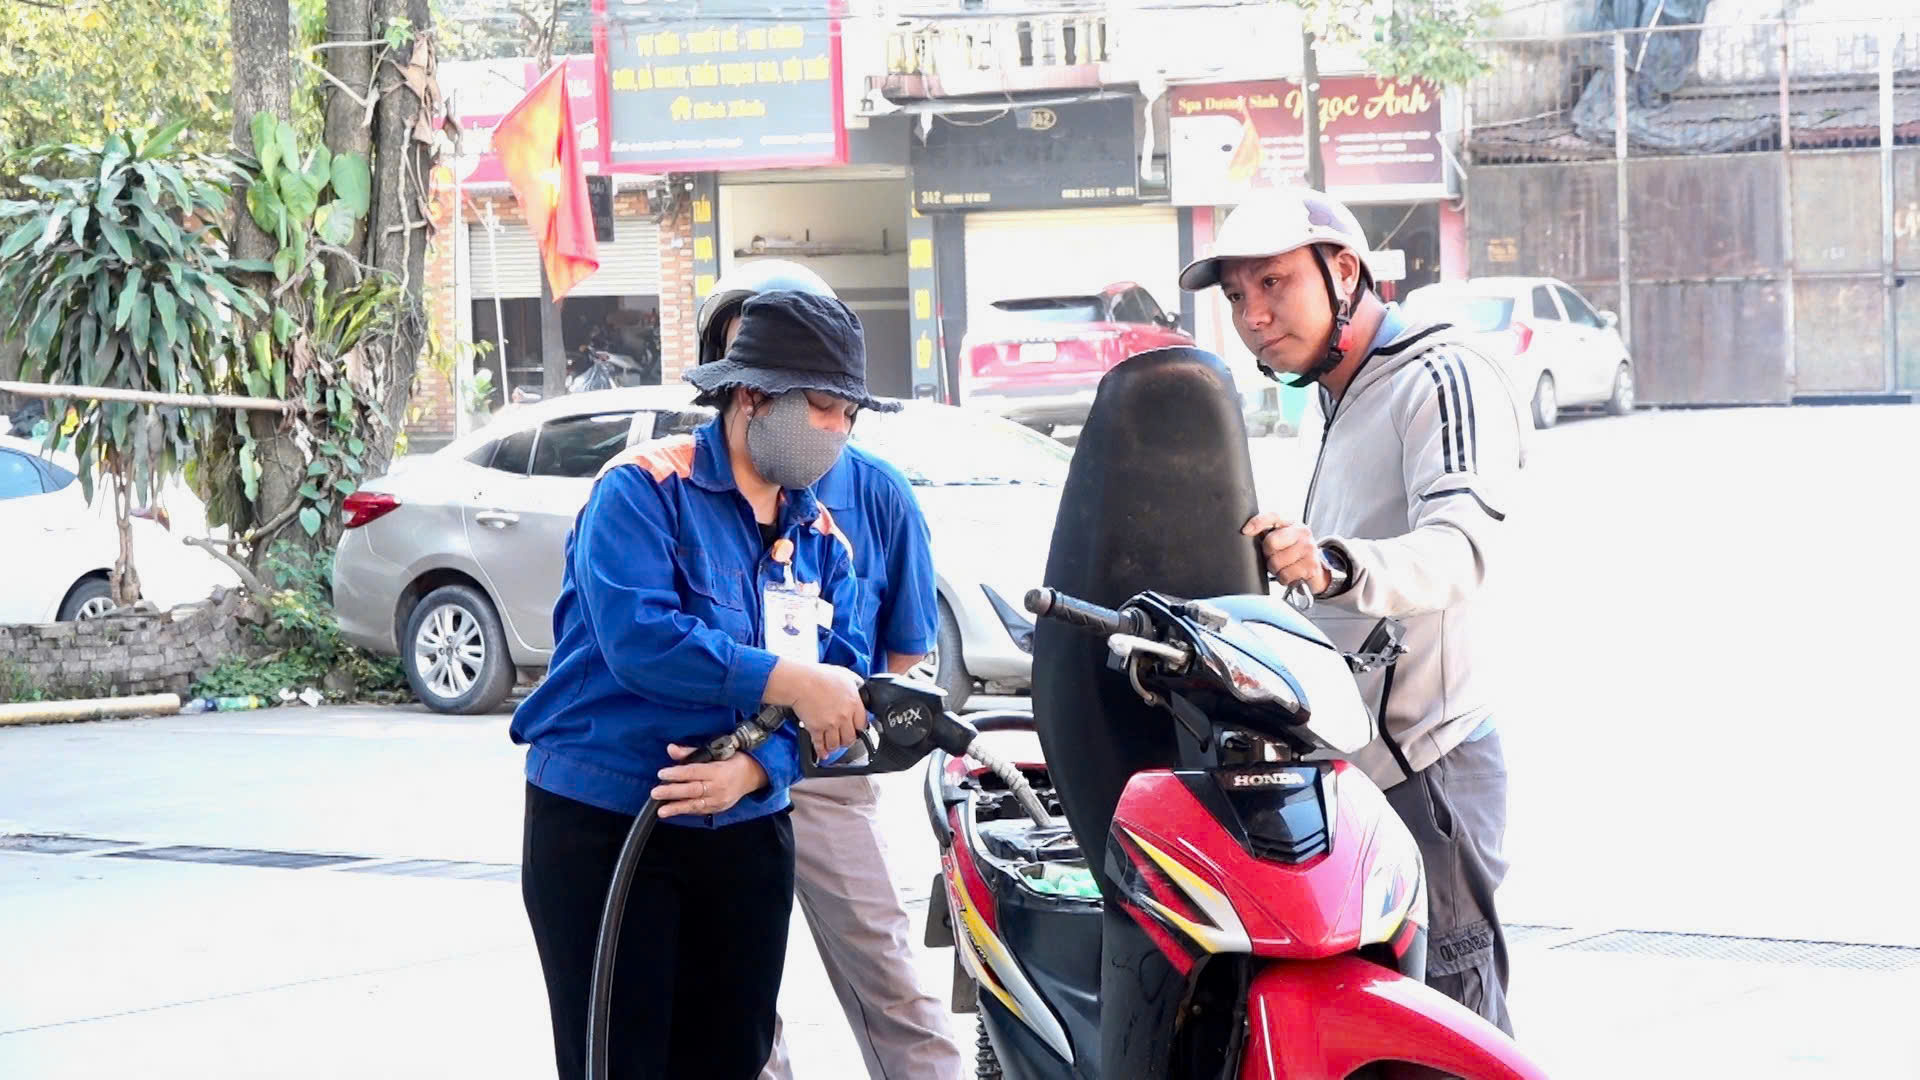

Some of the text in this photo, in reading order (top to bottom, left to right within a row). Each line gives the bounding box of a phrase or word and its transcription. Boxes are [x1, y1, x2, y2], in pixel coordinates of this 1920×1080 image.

[1364, 84, 1430, 120] Anh
[921, 191, 941, 204] 342
[1233, 773, 1305, 786] HONDA
